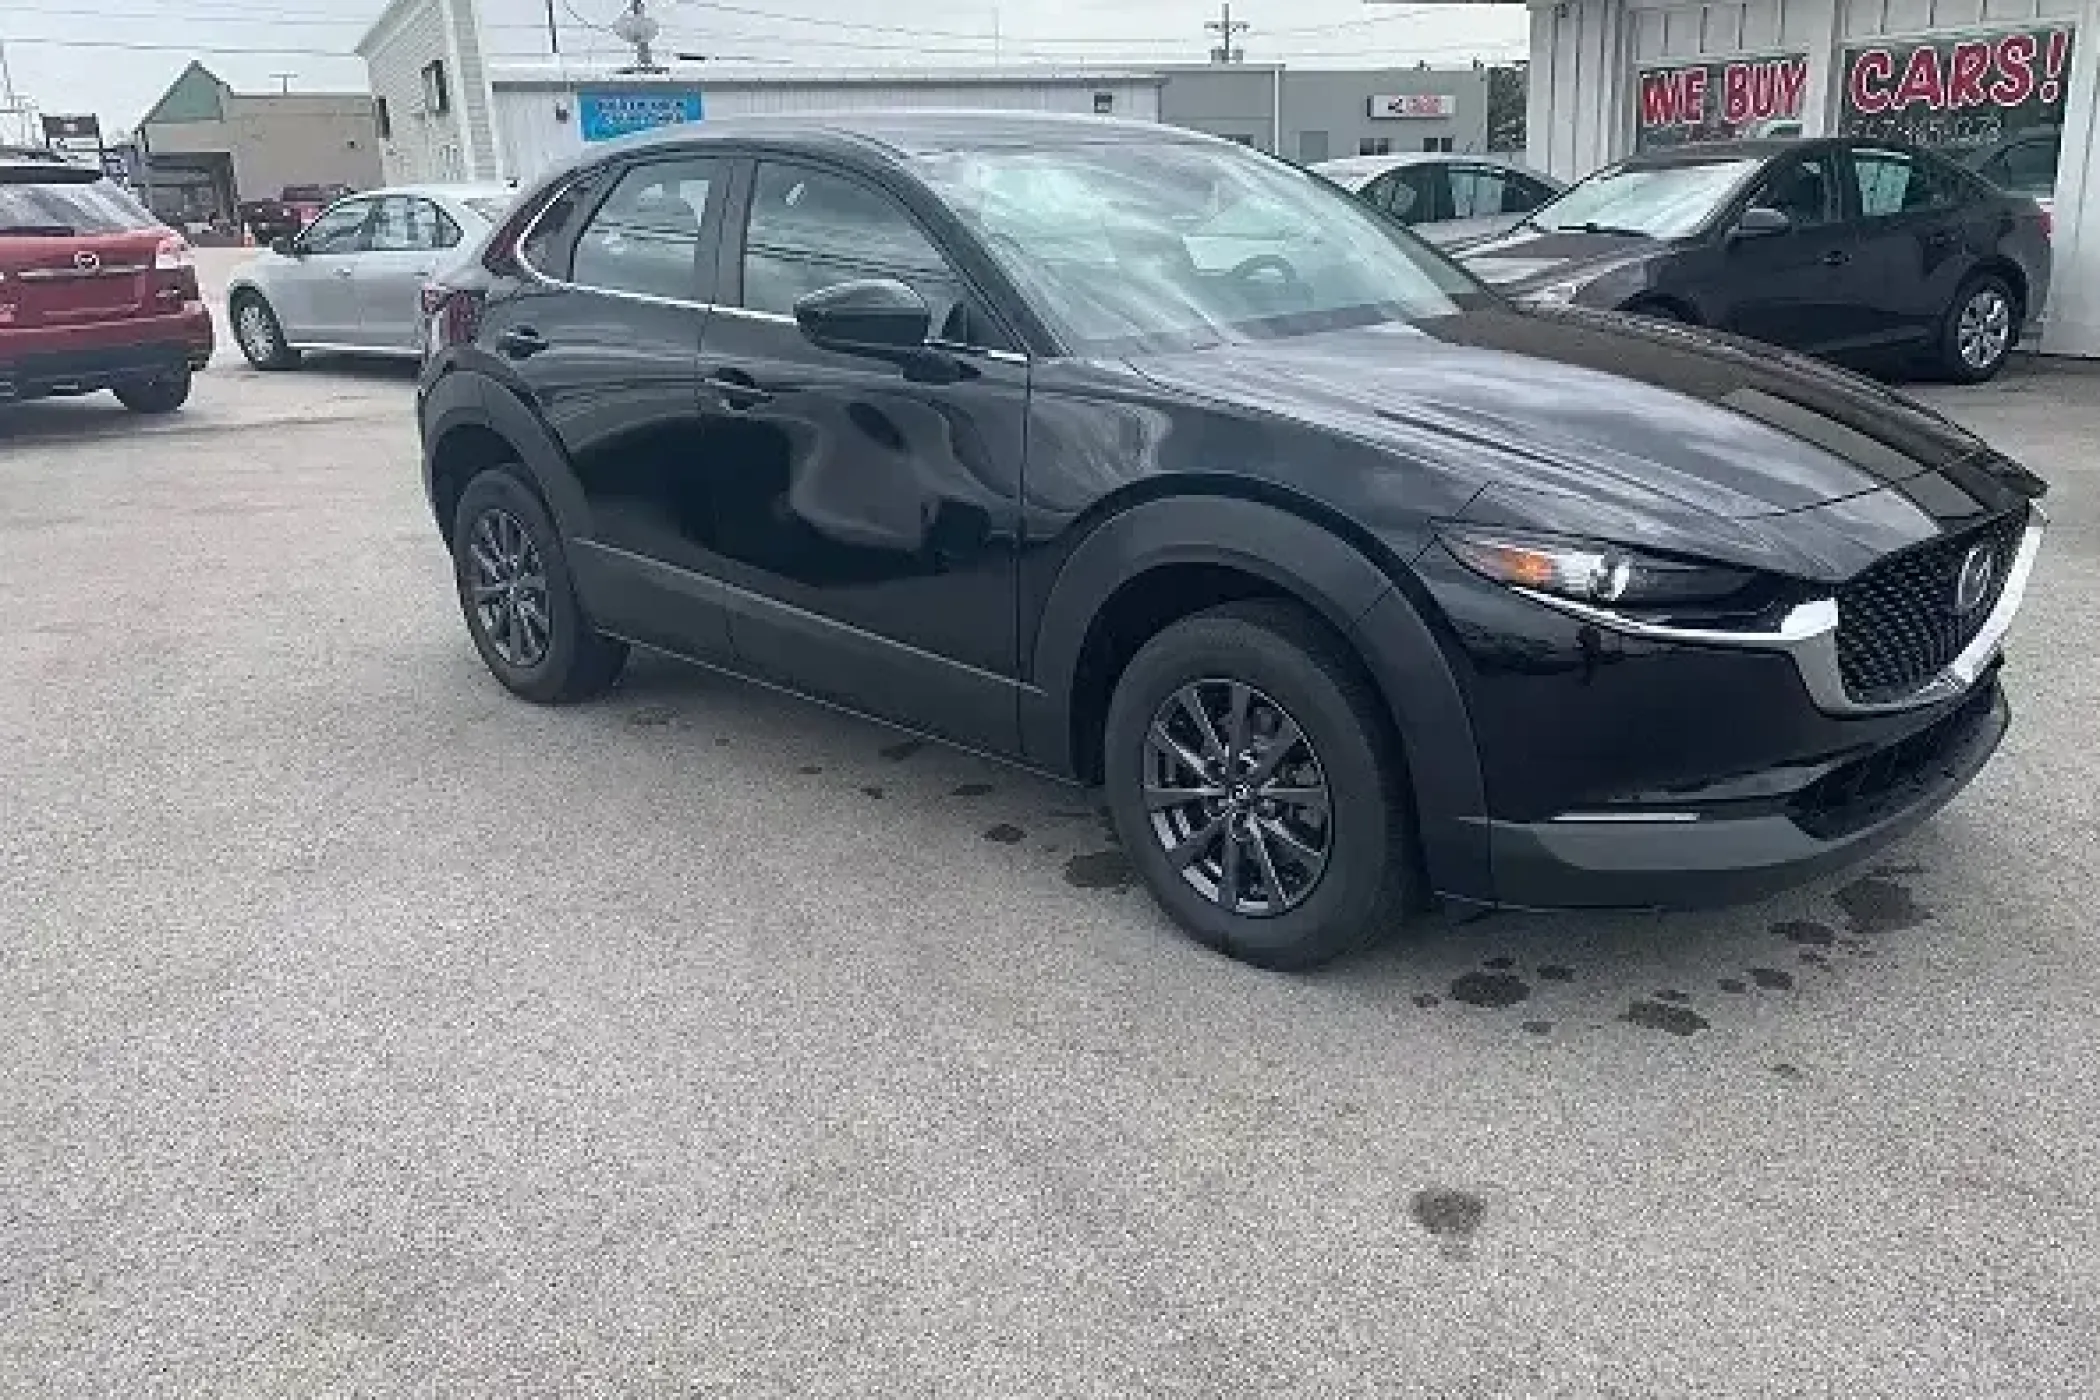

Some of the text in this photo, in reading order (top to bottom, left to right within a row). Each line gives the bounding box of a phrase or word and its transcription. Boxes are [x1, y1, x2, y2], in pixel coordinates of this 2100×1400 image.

[1639, 28, 2069, 127] WE BUY CARS!
